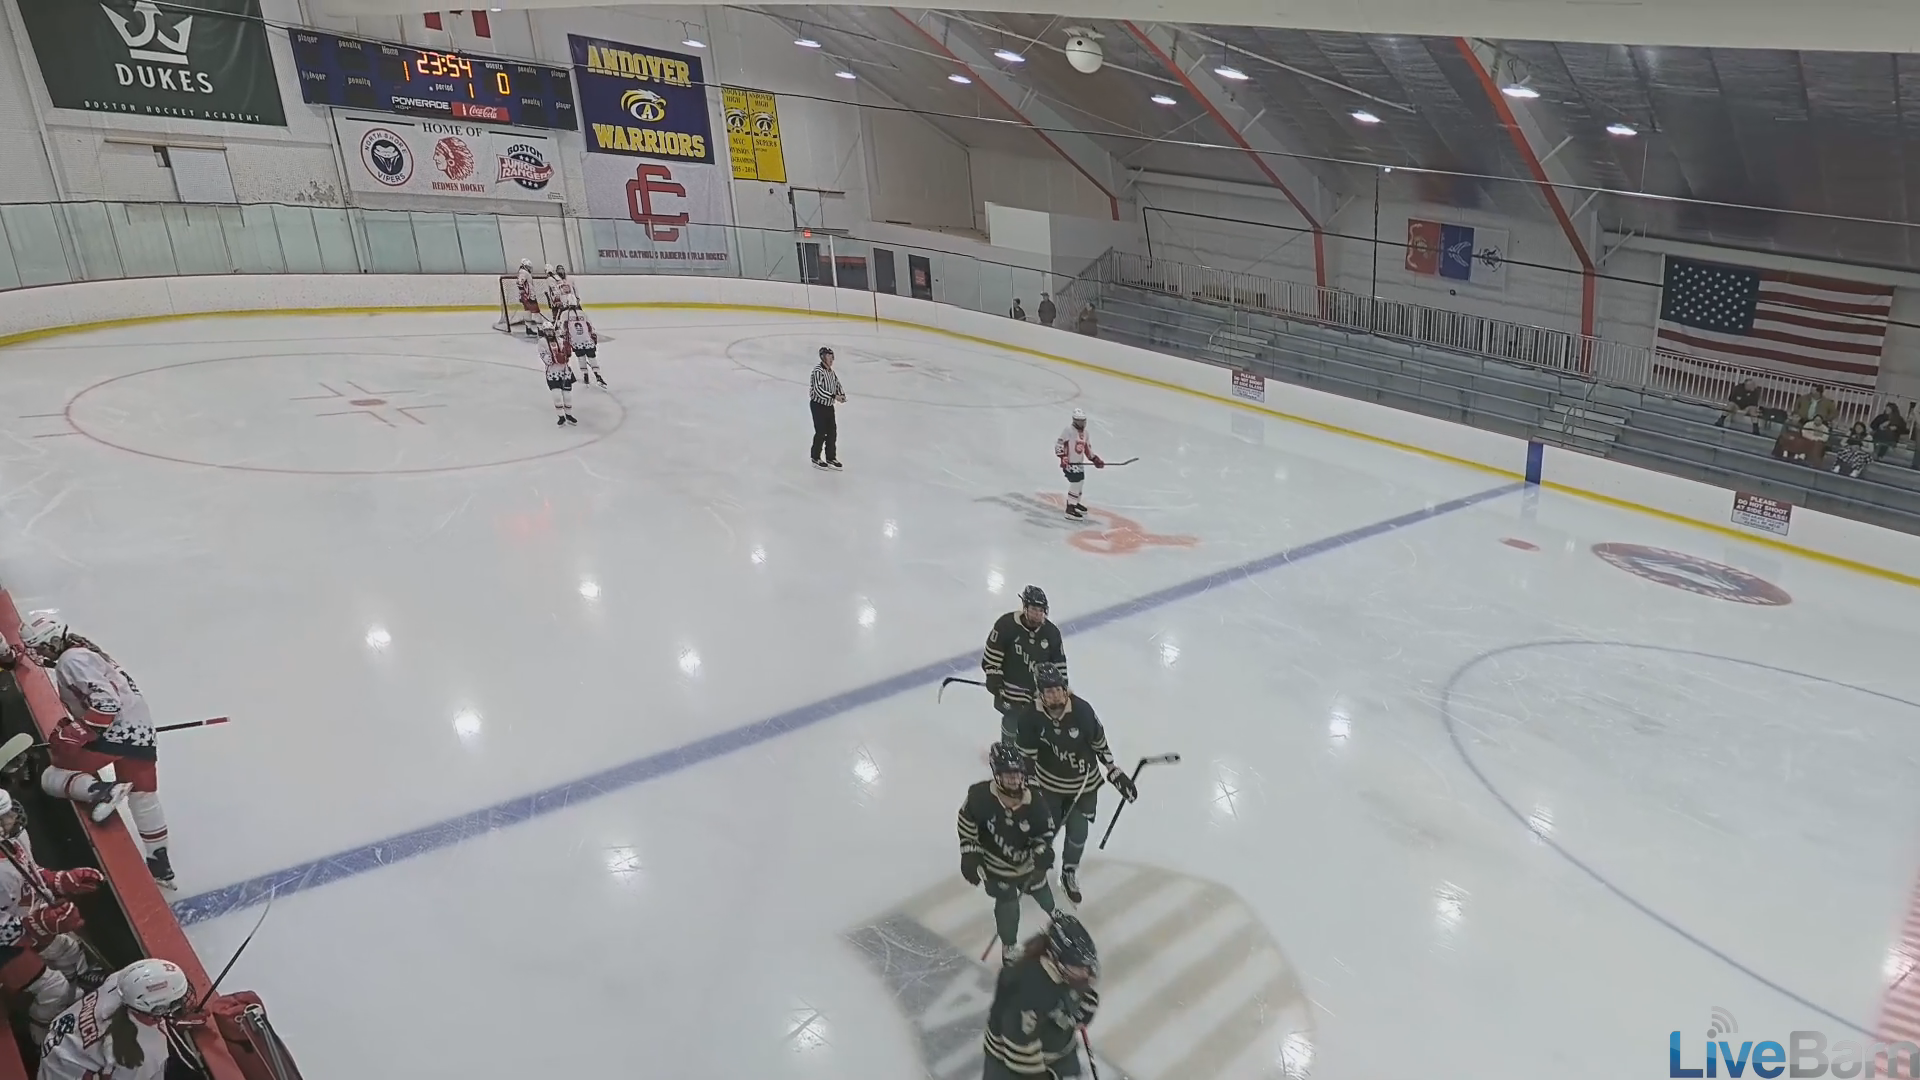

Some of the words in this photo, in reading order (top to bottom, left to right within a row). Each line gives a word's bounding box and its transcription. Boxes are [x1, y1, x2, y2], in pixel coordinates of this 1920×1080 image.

[402, 60, 410, 82] 1
[416, 51, 473, 79] 23:54
[587, 45, 692, 88] ANDOVER
[114, 63, 214, 95] DUKES
[496, 72, 510, 95] 0
[468, 83, 475, 99] 1
[84, 100, 136, 112] BOSTON
[146, 105, 195, 117] HOCKEY
[205, 110, 261, 123] ACADEMY
[422, 122, 462, 136] HOME
[466, 127, 483, 137] OF
[364, 132, 382, 152] NORTH
[384, 133, 407, 154] SHORE
[592, 123, 706, 158] WARRIORS
[507, 143, 543, 161] BOSTON
[503, 160, 536, 172] JUNIOR
[377, 171, 406, 183] VIPERS
[432, 181, 459, 191] REDMEN
[460, 184, 485, 193] HOCKEY
[629, 250, 658, 260] CATHOLC
[1737, 498, 1749, 506] DO
[1749, 501, 1764, 509] NOT
[1764, 505, 1789, 515] SHOOT
[1746, 506, 1762, 515] SIDE
[1750, 496, 1778, 507] PLEASE
[1015, 643, 1036, 674] DUK
